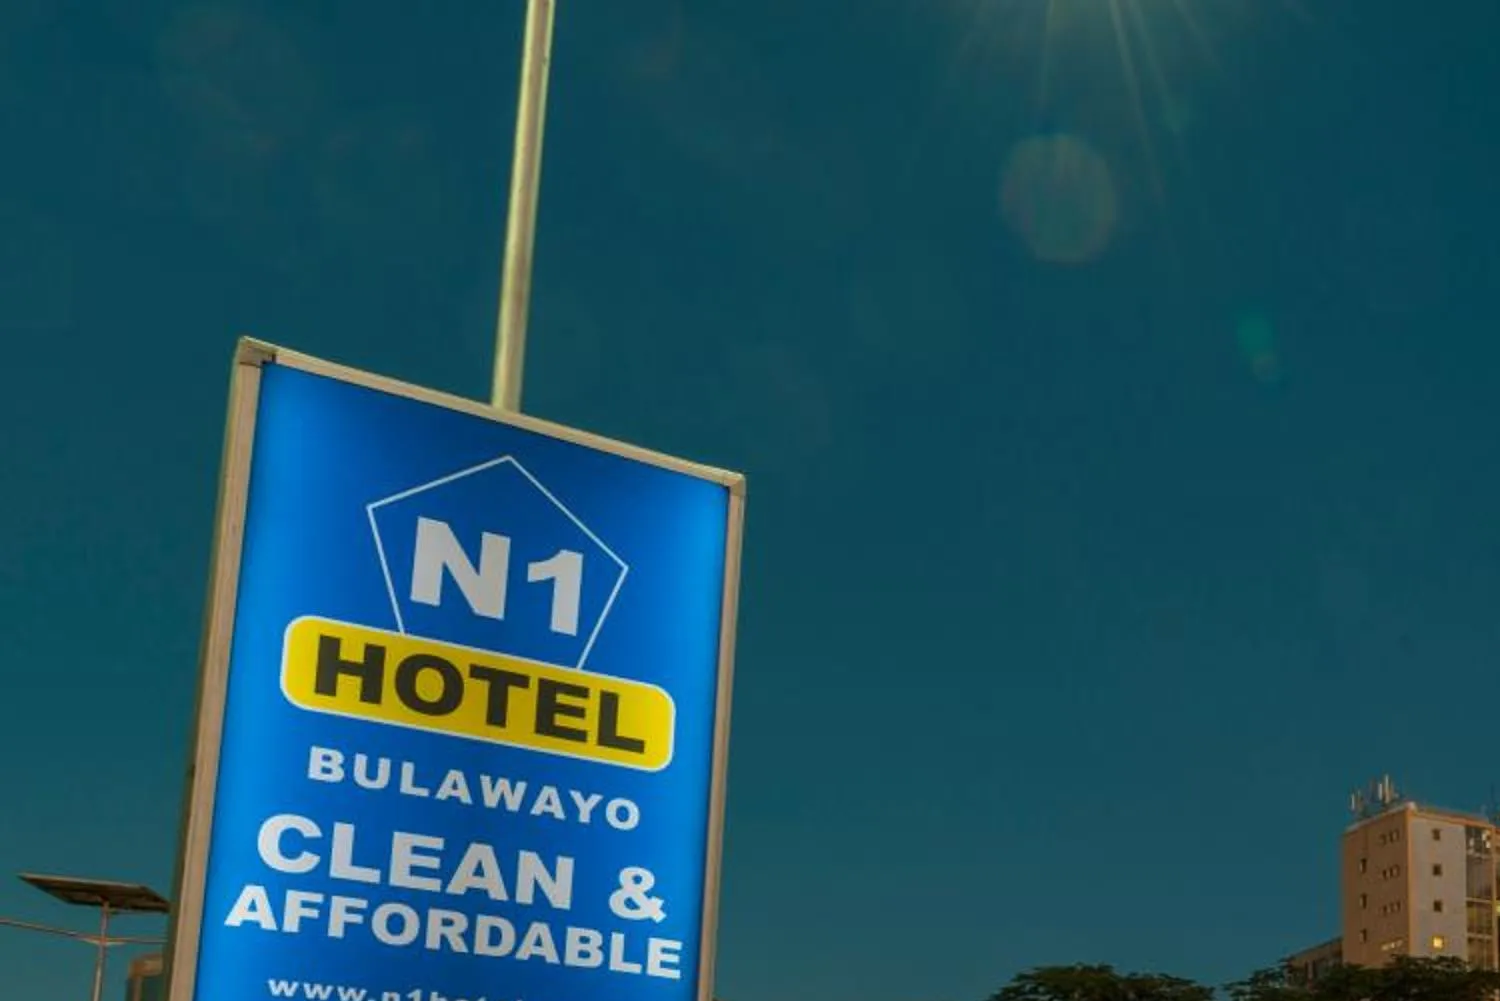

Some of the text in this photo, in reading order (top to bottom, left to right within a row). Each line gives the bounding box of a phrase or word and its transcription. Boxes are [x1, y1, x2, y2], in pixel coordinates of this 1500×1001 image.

[411, 516, 584, 636] N1
[313, 635, 645, 754] HOTEL
[308, 745, 641, 830] BULAWAYO
[256, 814, 668, 922] CLEAN &
[225, 884, 683, 979] AFFORDABLE
